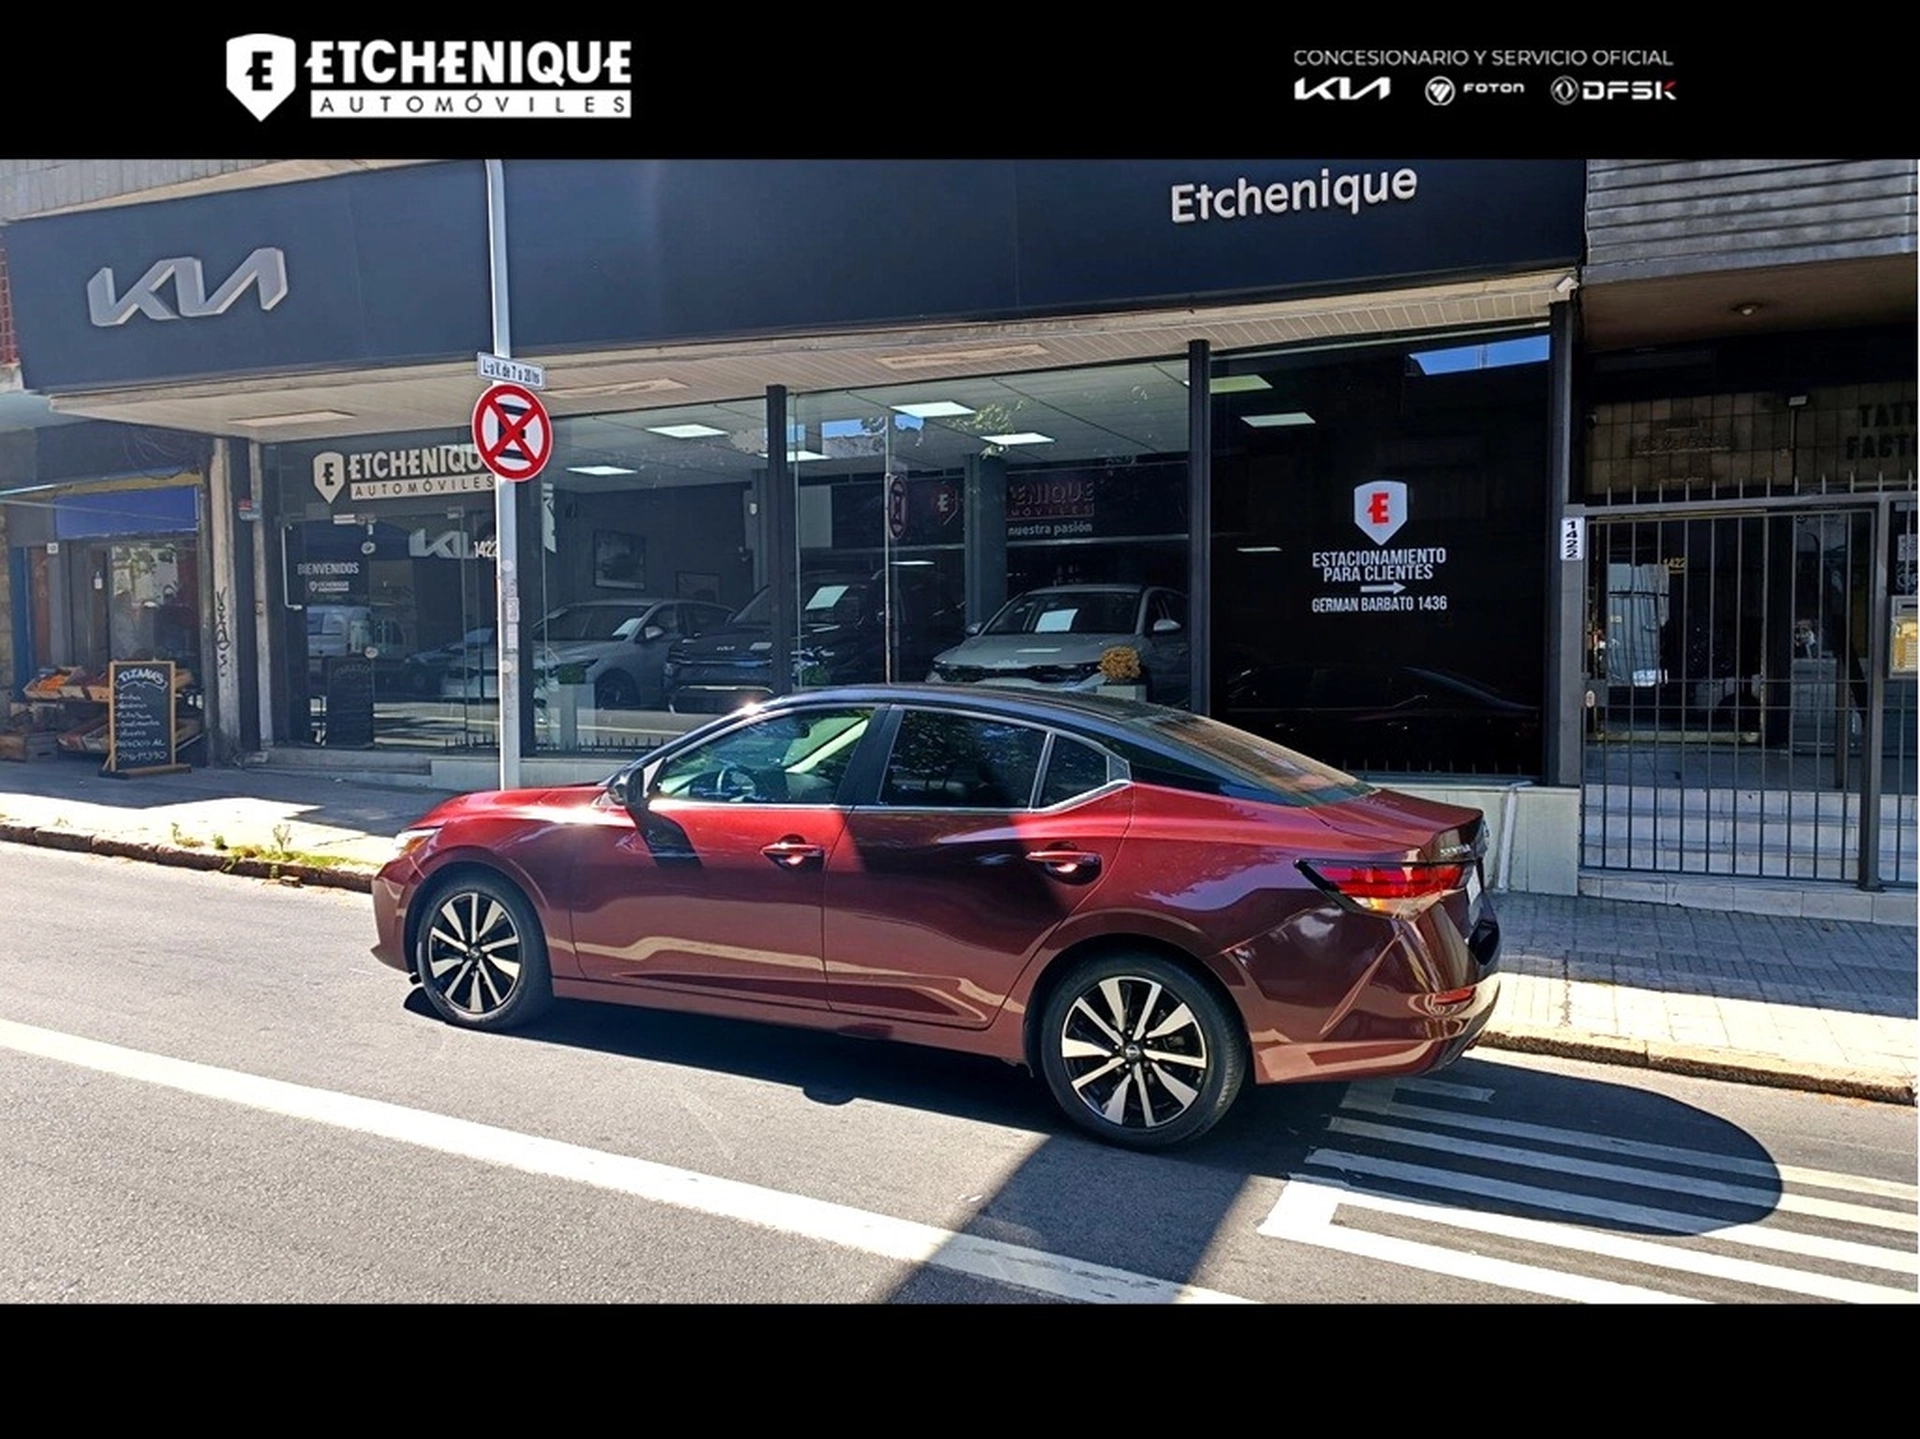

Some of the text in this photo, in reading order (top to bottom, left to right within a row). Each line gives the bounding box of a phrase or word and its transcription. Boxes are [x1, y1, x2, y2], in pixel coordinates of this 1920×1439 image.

[1171, 167, 1418, 224] Etchenique
[1846, 433, 1916, 460] FACT
[347, 444, 483, 480] ETCHENIQU
[354, 475, 494, 497] AUTOMÓVILES
[1008, 521, 1093, 536] nuestra pasión
[1566, 520, 1578, 558] 1422
[1312, 547, 1447, 568] ESTACIONAMIENTO
[297, 562, 360, 576] BIENVENIDOS
[1323, 564, 1434, 582] PARA CLIENTES
[1311, 595, 1448, 613] GERMAN BARBATO 1436
